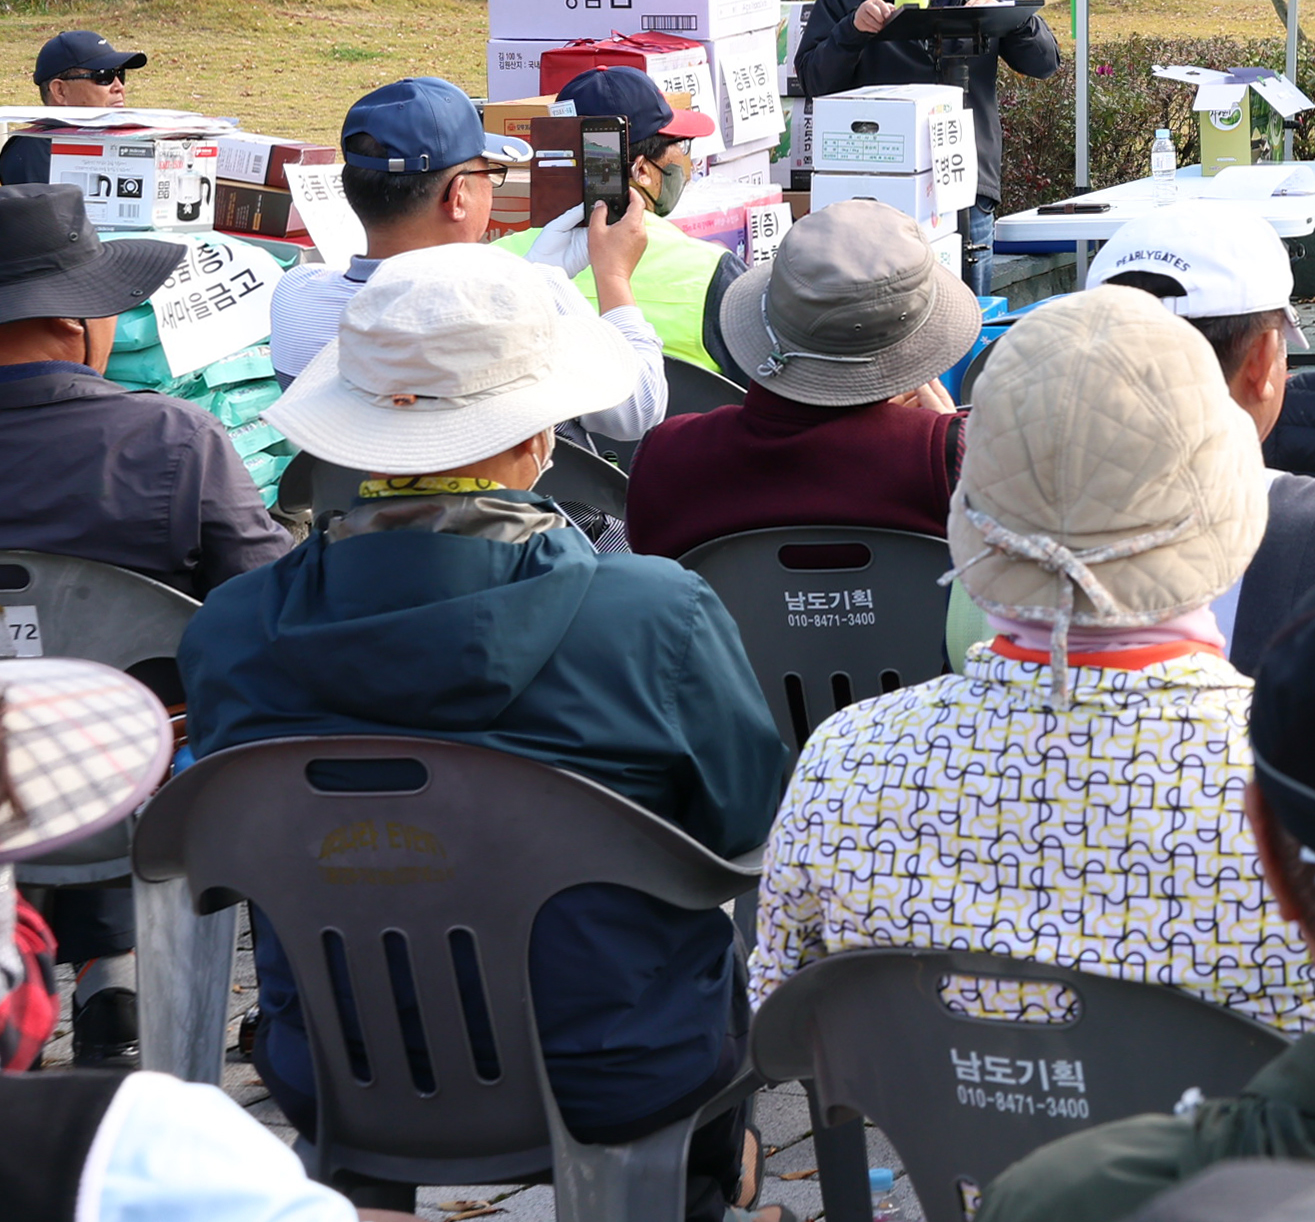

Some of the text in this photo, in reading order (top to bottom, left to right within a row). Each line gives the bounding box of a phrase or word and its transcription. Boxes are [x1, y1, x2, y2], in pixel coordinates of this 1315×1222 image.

[505, 52, 515, 61] 100
[528, 60, 541, 70] 국내
[1115, 250, 1192, 272] PEARLYGATES
[161, 267, 265, 330] 새마을금고
[784, 588, 874, 612] 남도기획
[787, 611, 876, 628] 010-8471-3400
[949, 1047, 1088, 1095] 남도기획
[956, 1083, 1090, 1120] 010-8471-3400
